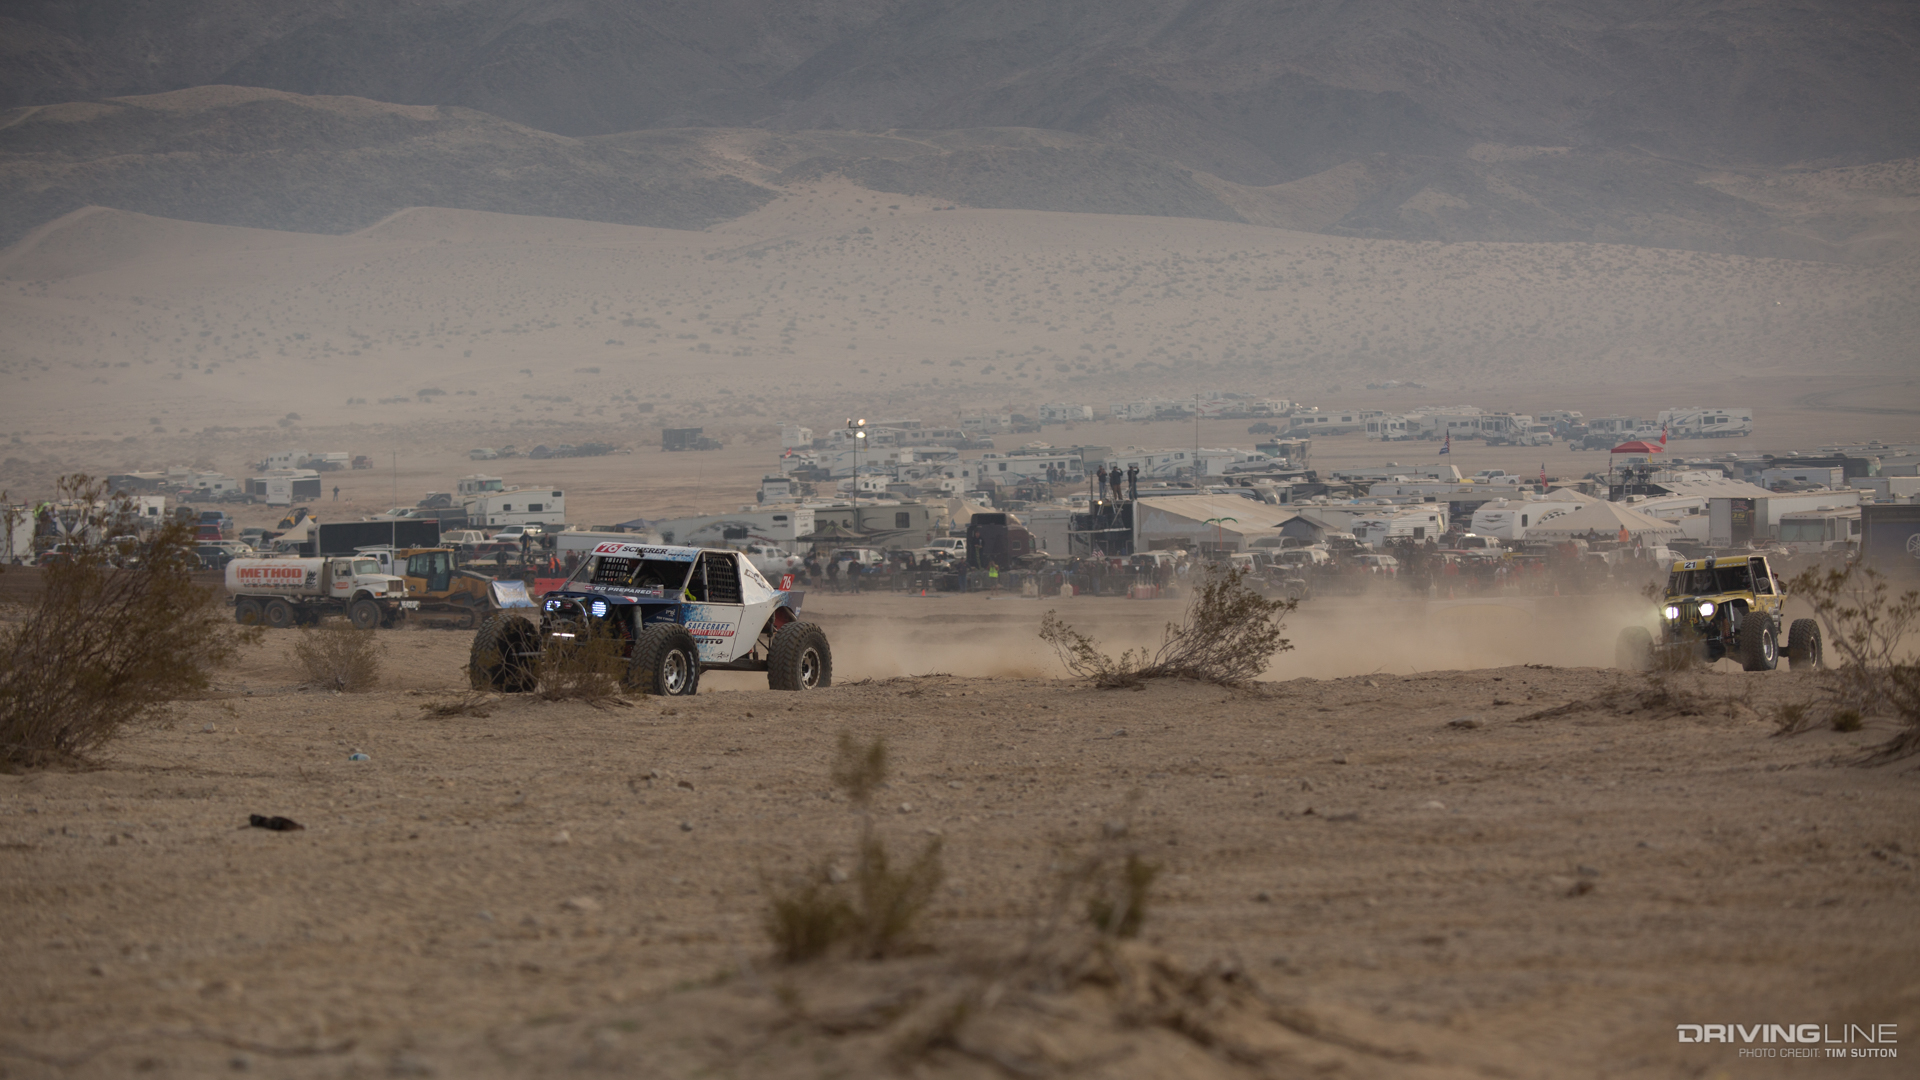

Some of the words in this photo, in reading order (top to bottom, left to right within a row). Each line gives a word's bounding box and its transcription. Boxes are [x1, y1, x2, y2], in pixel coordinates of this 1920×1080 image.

[601, 543, 618, 552] 76
[622, 546, 668, 554] SCHERER
[240, 568, 302, 578] METHOD
[782, 576, 792, 590] 76
